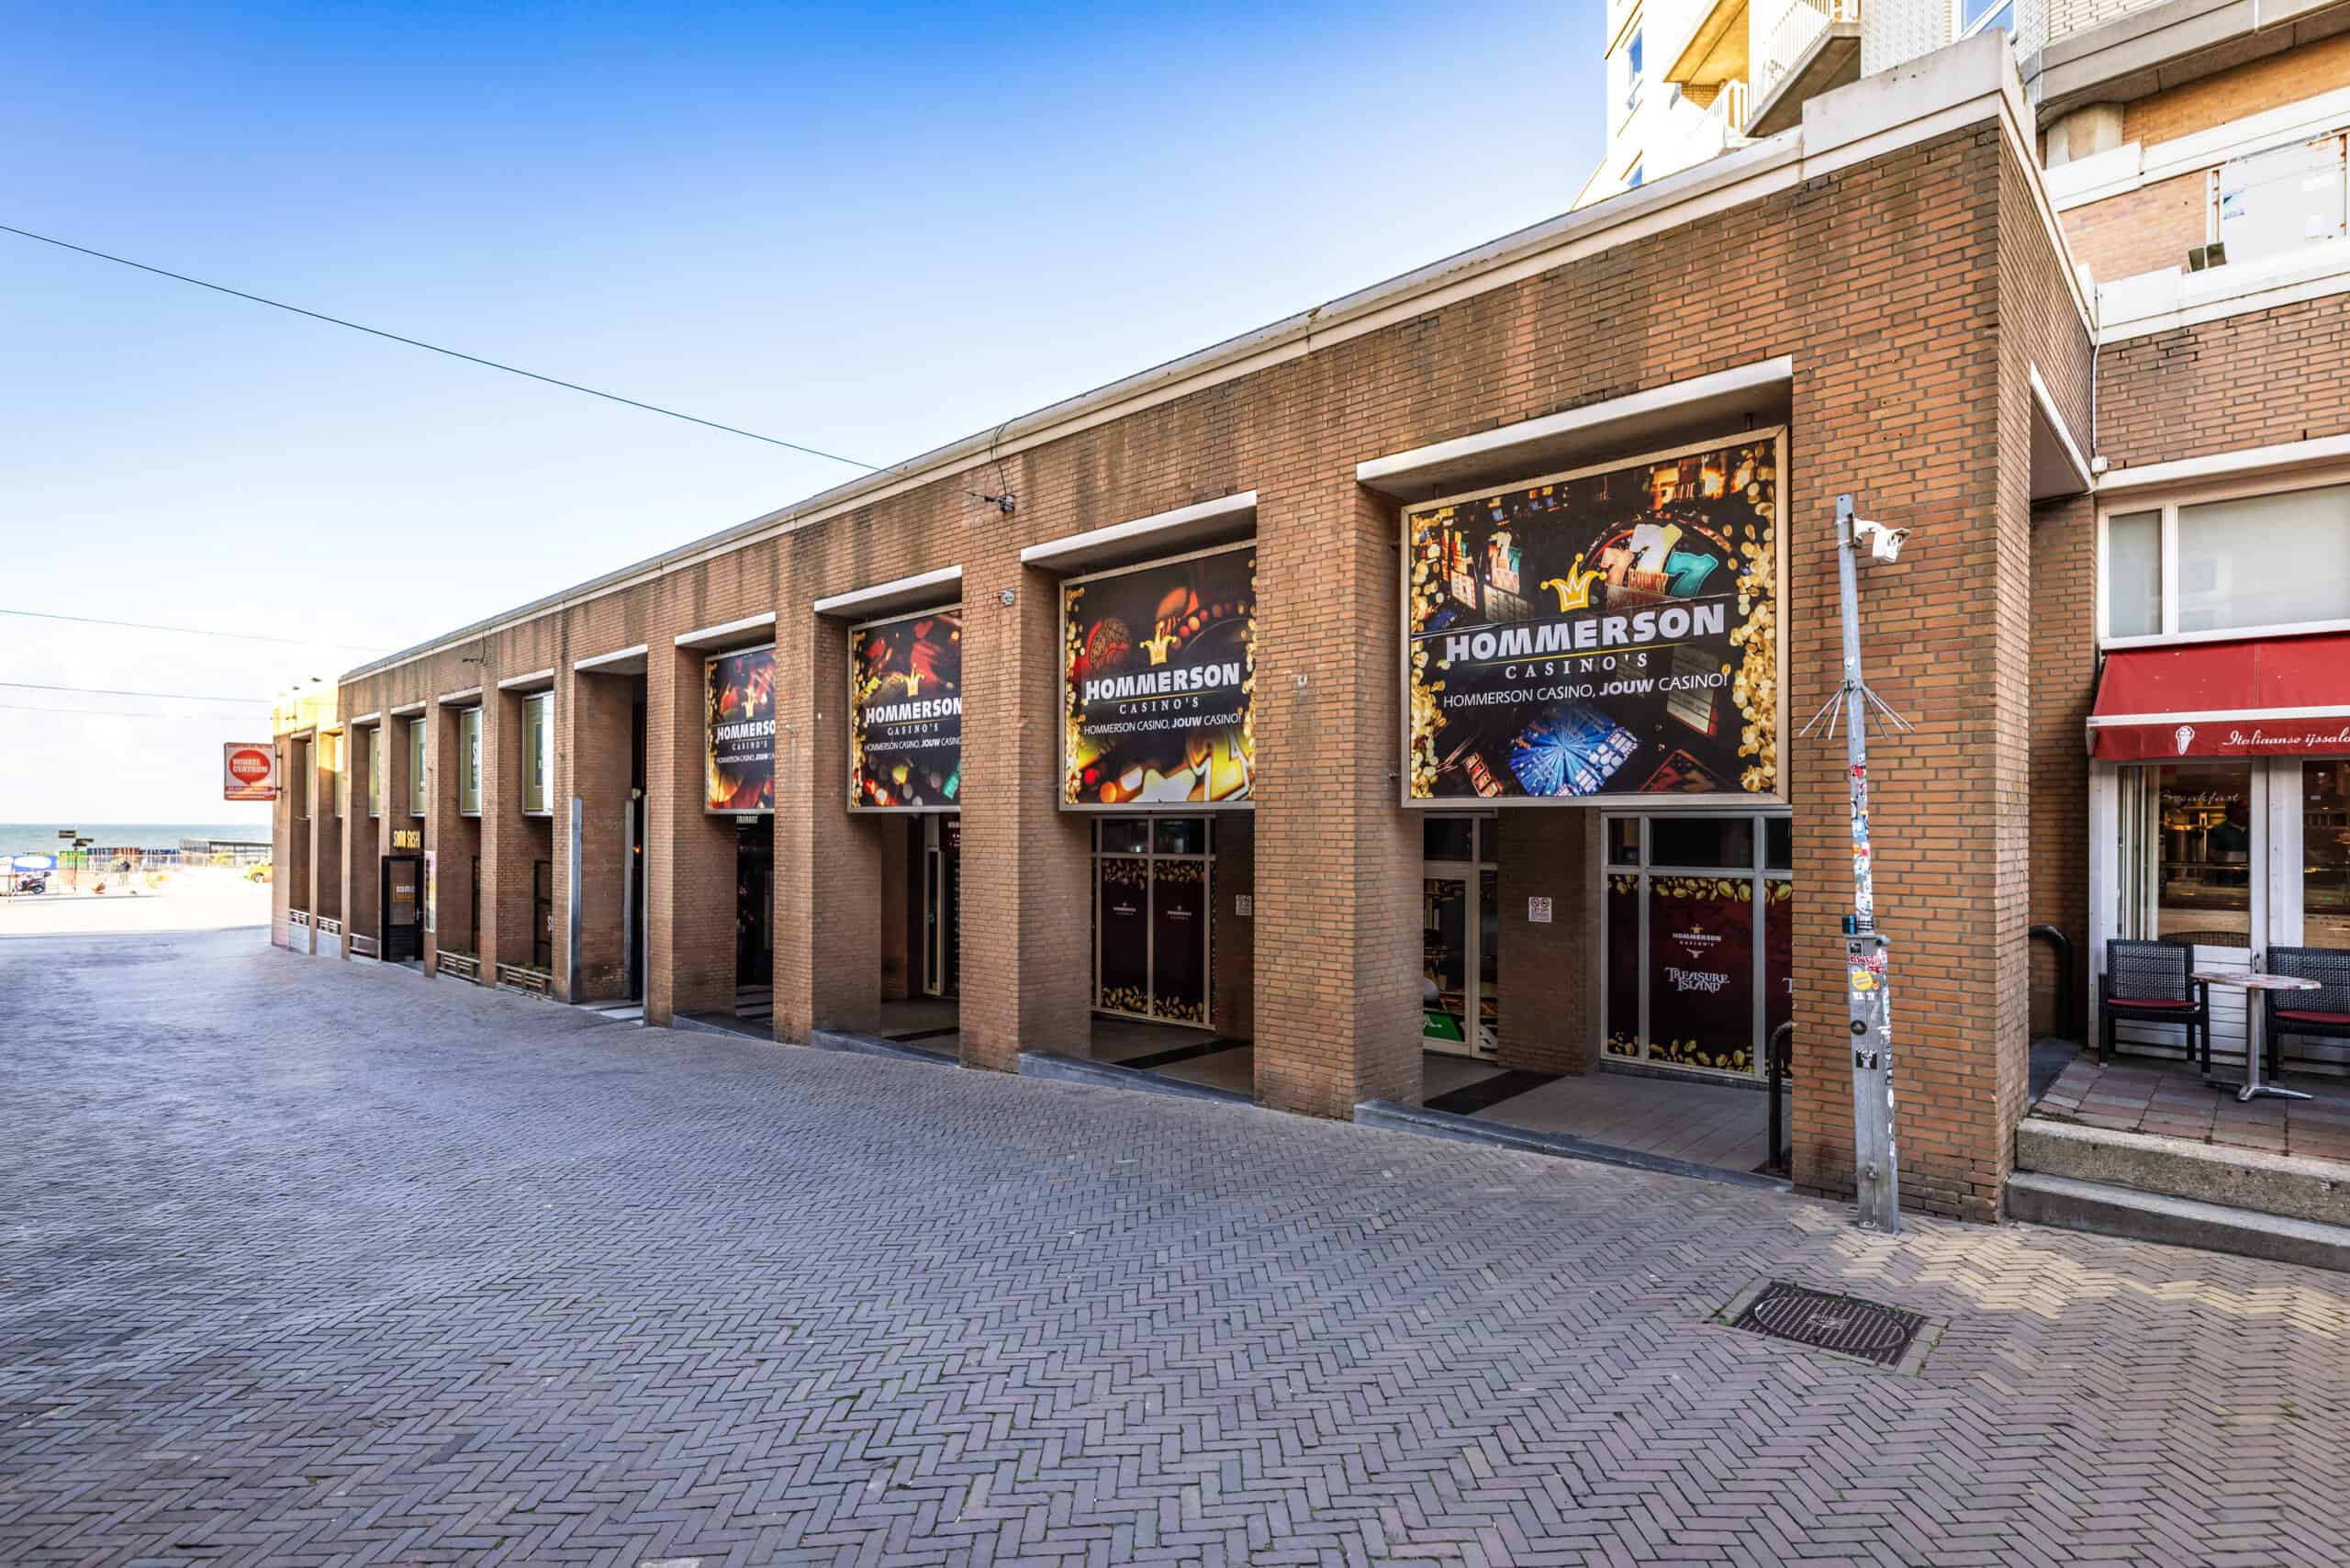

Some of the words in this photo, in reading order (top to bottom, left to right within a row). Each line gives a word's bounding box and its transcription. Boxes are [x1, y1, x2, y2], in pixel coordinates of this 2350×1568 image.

[1446, 603, 1725, 662] HOMMERSON
[1505, 653, 1648, 679] CASINO'S
[1085, 662, 1240, 700] HOMMERSON
[1443, 689, 1534, 708] HOMMERSON
[1537, 684, 1595, 700] CASINO,
[1599, 678, 1654, 696] JOUW
[1659, 672, 1729, 691] CASINO!
[866, 697, 962, 723] HOMMERSON
[1119, 697, 1199, 714] CASINO'S
[716, 720, 777, 741] HOMMERSO
[887, 722, 939, 736] CASINO'S
[1084, 722, 1136, 735] HOMMERSON
[1136, 719, 1170, 732] CASINO,
[1171, 716, 1203, 729] JOUW
[921, 738, 941, 747] JOUW
[2221, 729, 2301, 746] Italiaanse
[1664, 967, 1731, 985] TREASURE
[1676, 977, 1721, 993] ISLAND
